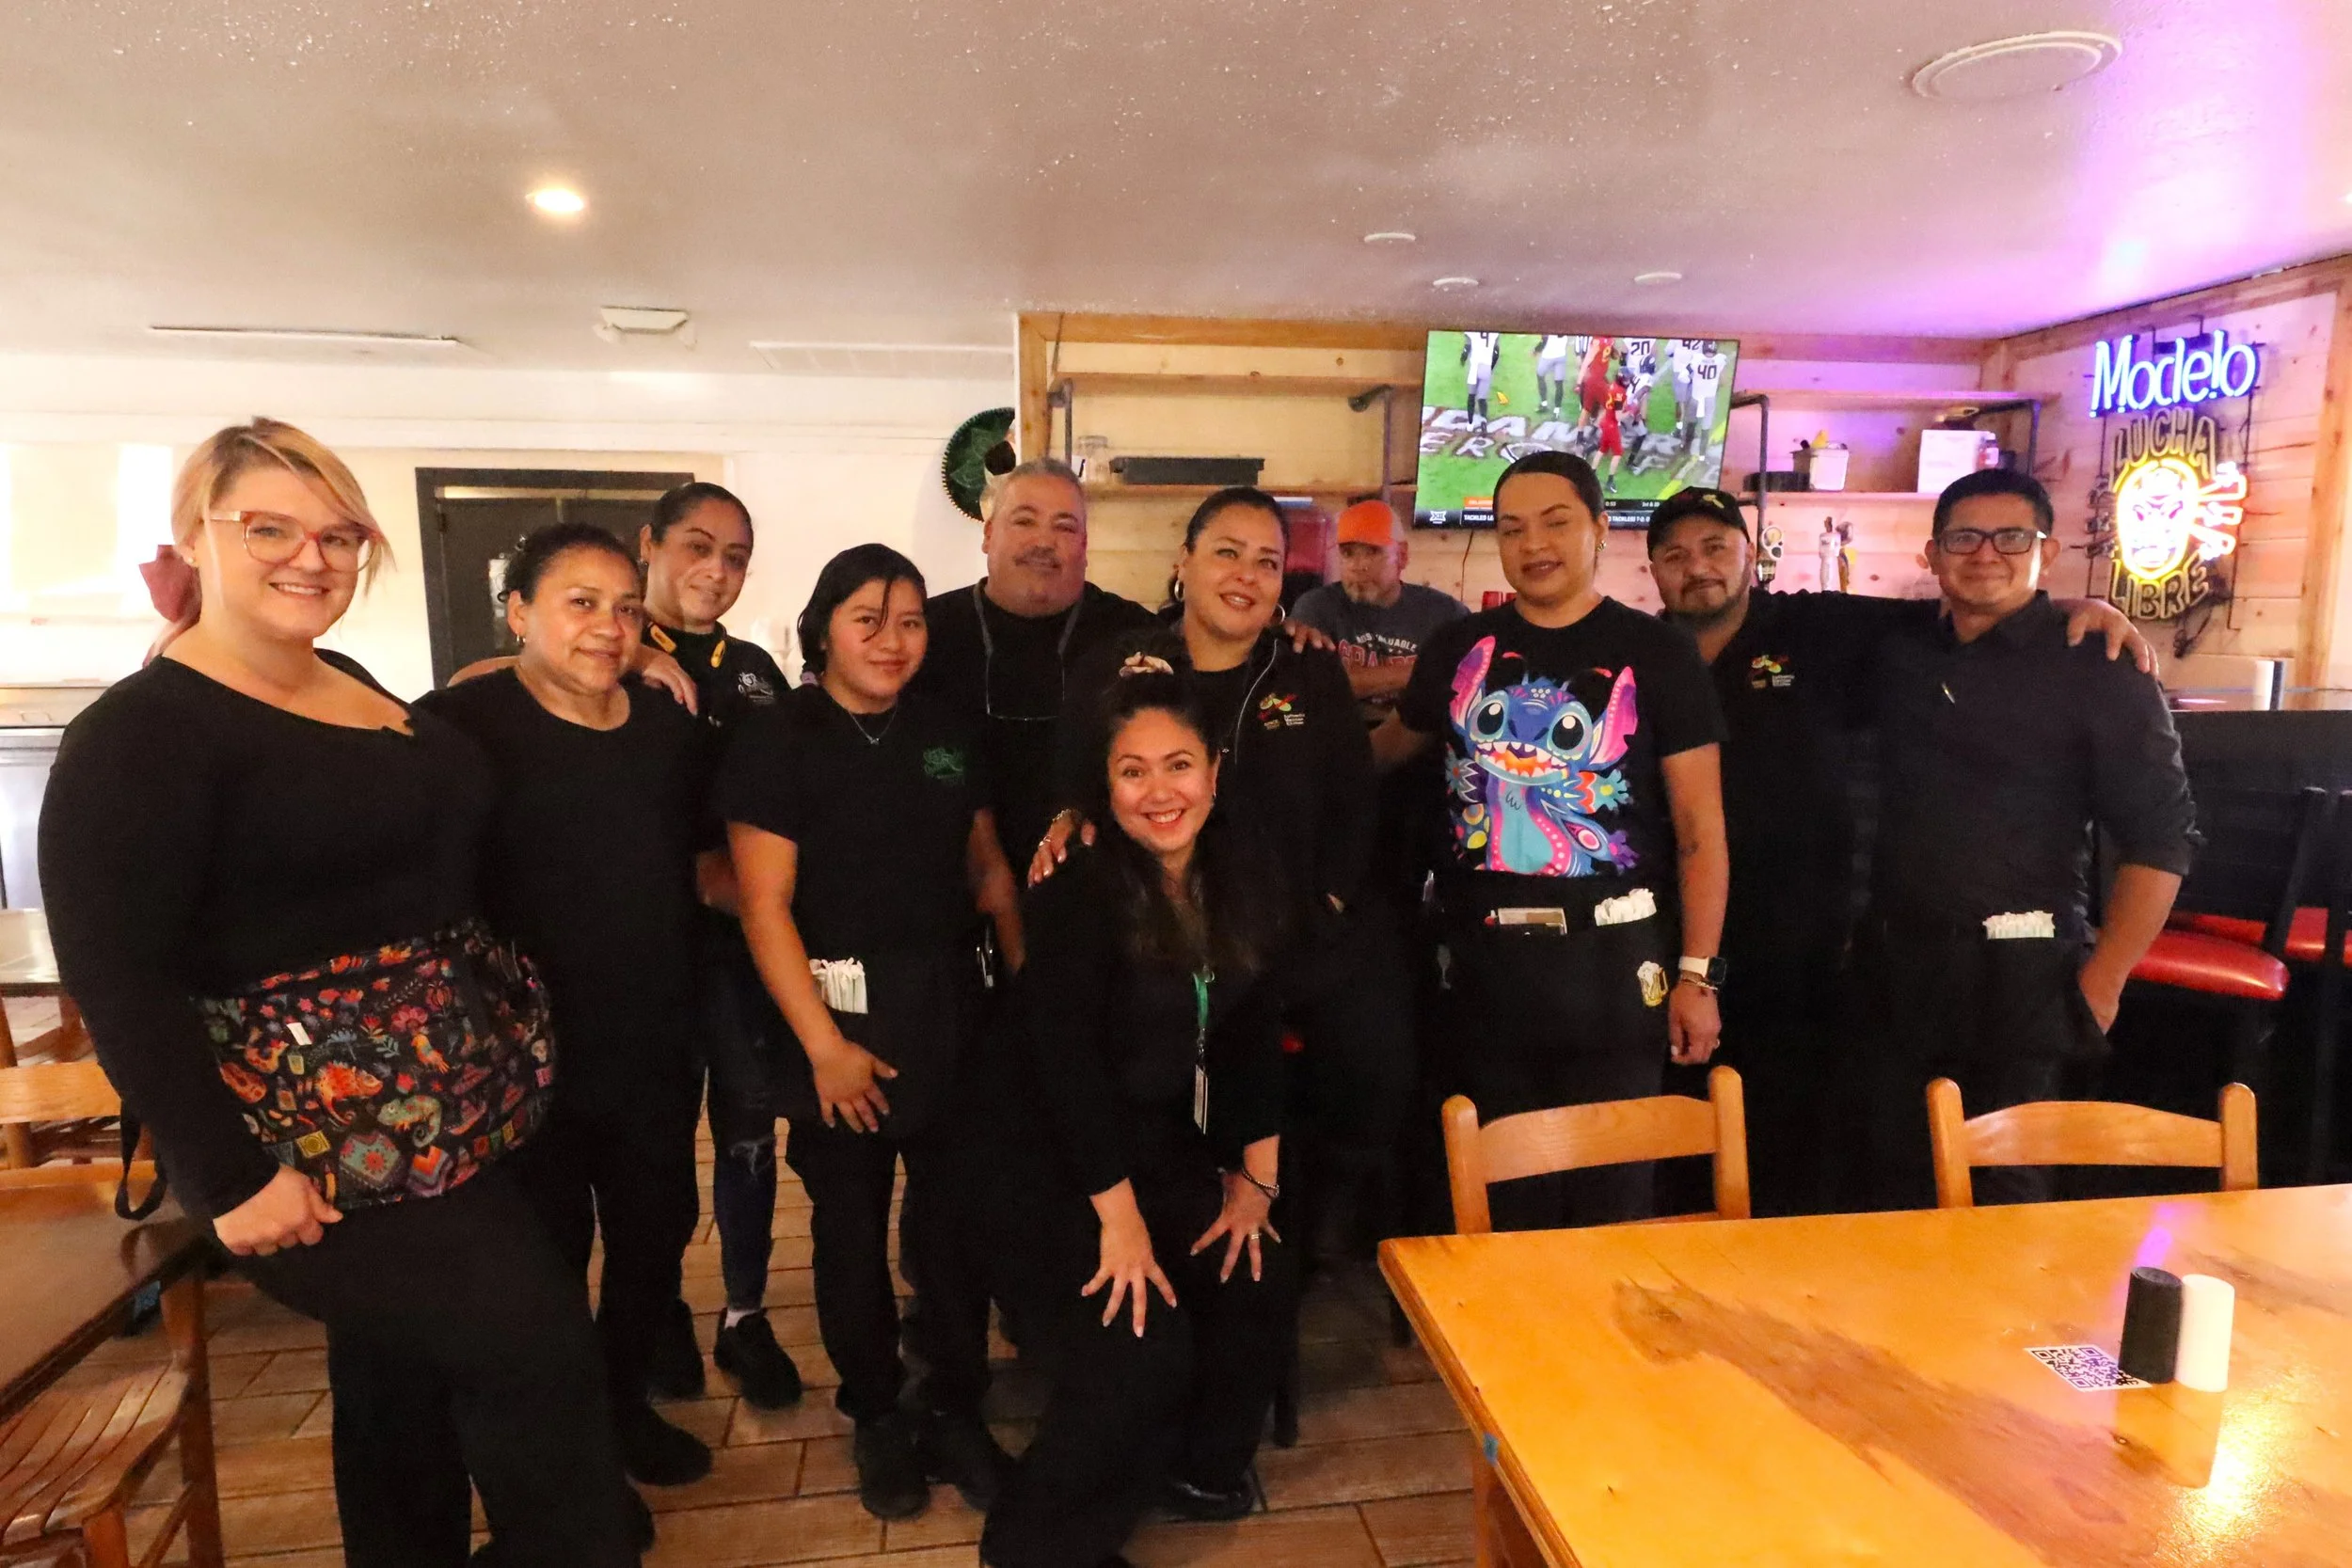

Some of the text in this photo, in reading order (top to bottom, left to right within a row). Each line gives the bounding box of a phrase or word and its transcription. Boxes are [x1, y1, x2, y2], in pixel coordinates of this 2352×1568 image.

[1630, 341, 1650, 356] 20
[1697, 364, 1717, 379] 40
[2090, 329, 2256, 419] Modelo
[2108, 406, 2217, 493] LUCHA
[2110, 549, 2210, 620] LIBRE
